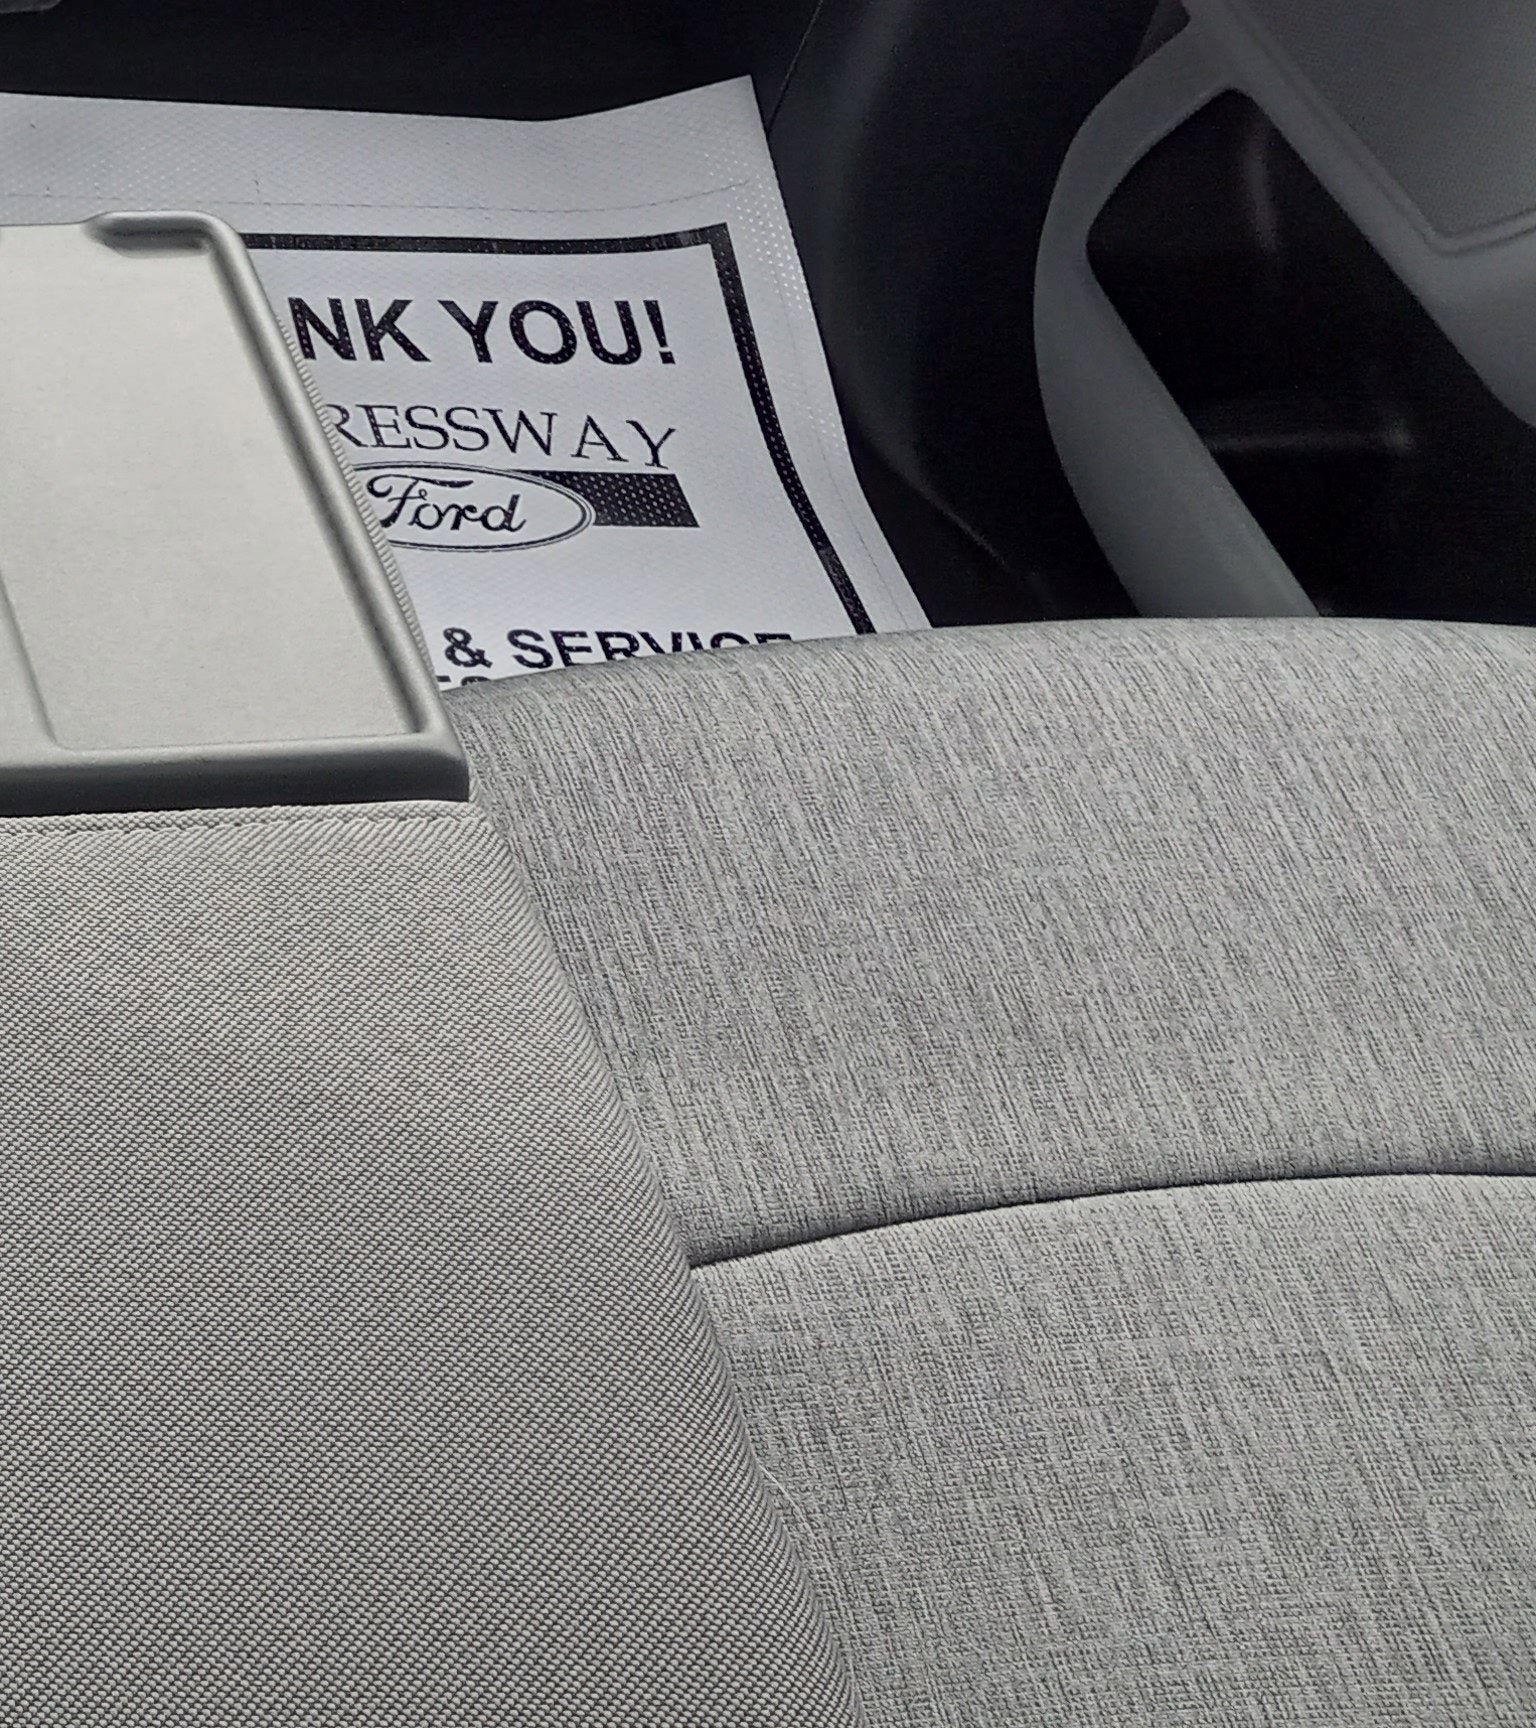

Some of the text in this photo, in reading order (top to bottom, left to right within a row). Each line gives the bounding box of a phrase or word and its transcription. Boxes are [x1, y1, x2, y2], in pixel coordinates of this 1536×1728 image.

[438, 300, 677, 365] YOU!
[326, 403, 677, 470] RESSWAY
[367, 473, 527, 533] Ford
[443, 627, 493, 668] &
